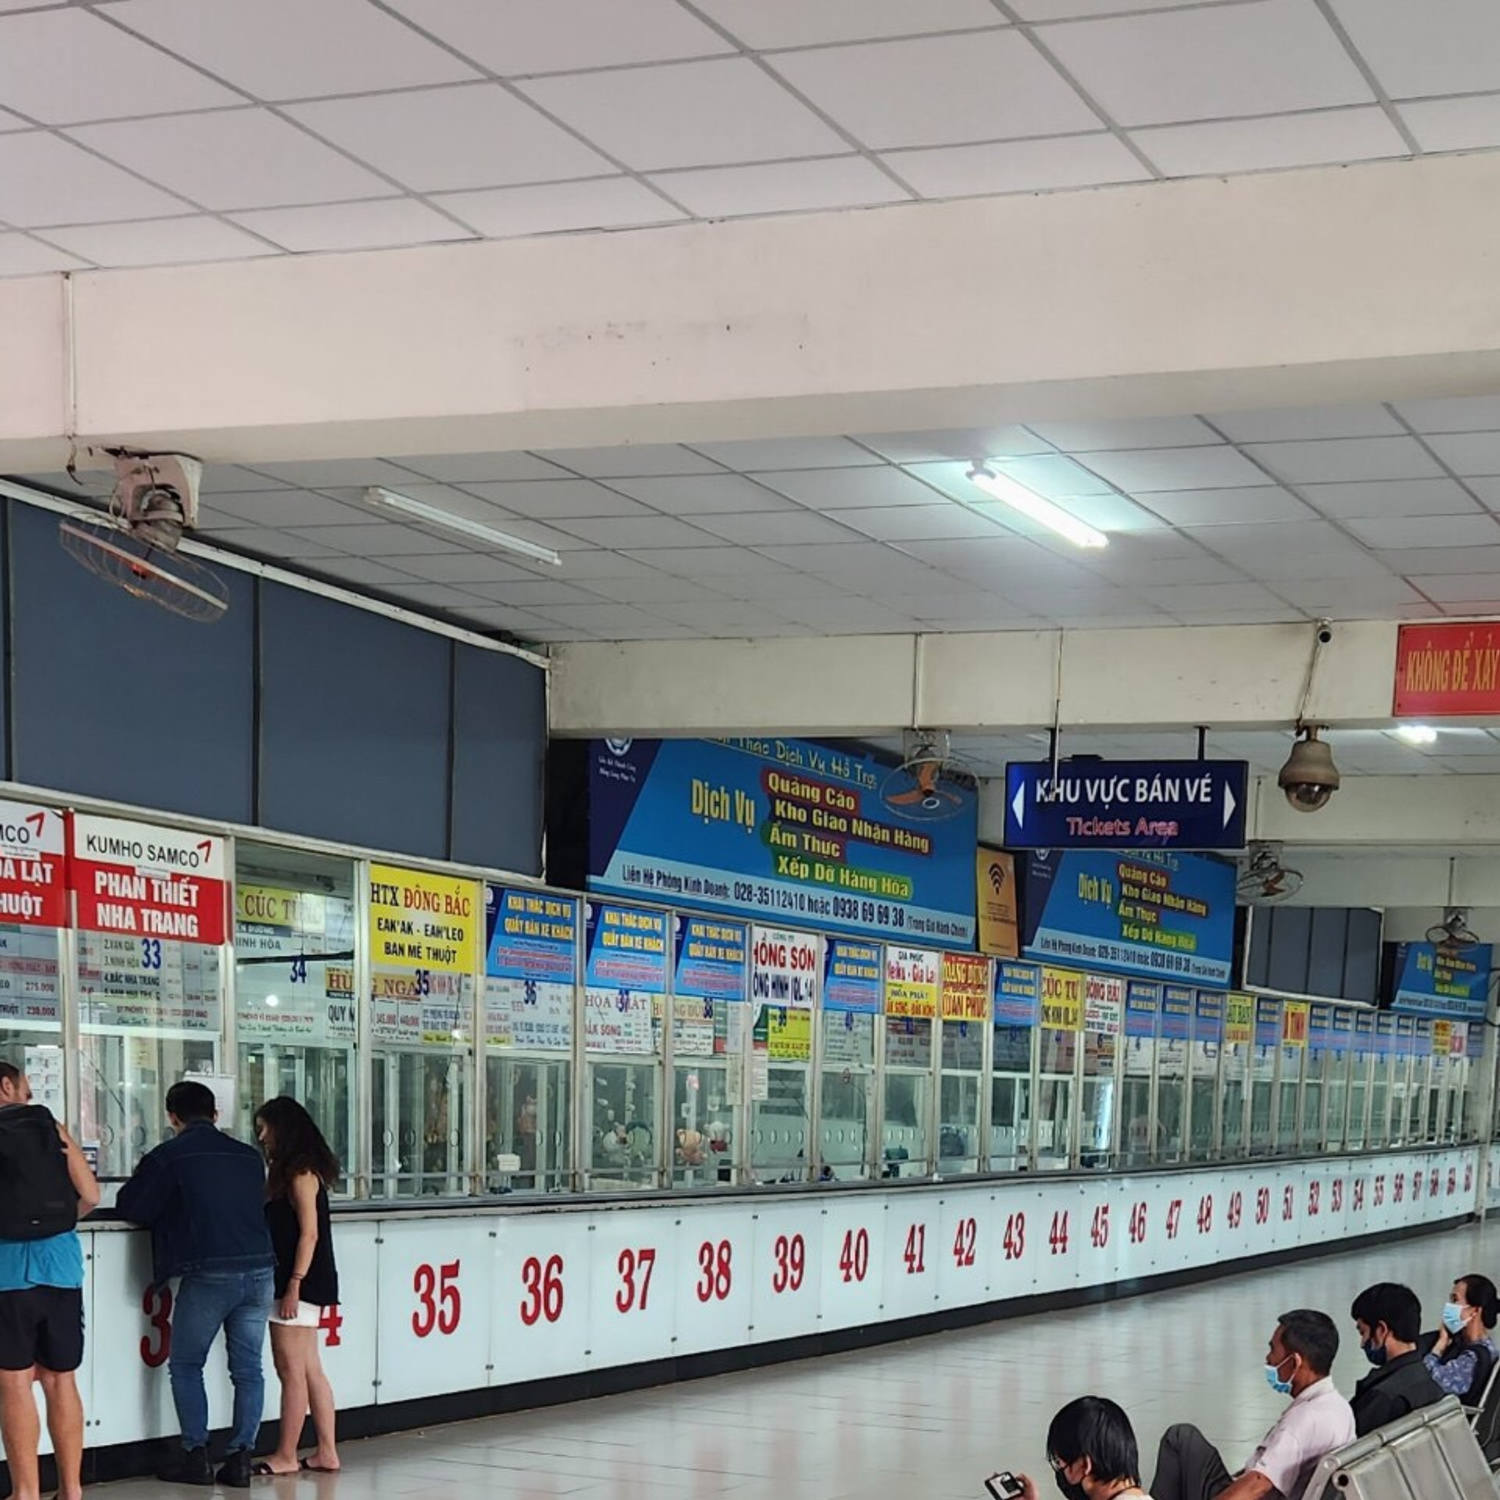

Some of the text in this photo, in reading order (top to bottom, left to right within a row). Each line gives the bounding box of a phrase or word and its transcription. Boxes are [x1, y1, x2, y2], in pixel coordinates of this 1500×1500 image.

[1407, 642, 1448, 692] KHÔNG
[1452, 631, 1474, 691] ĐỂ
[1474, 633, 1500, 690] XẢY
[776, 740, 803, 768] Dịch
[808, 746, 825, 775] Vụ
[691, 779, 755, 834] Dịch Vụ
[768, 771, 855, 810] Quảng Cáo
[1036, 774, 1213, 810] KHU VỰC BÁN VÉ
[770, 821, 841, 858] Ẩm Thực
[775, 799, 929, 854] Kho Giao Nhận Hàng
[1066, 817, 1179, 836] Tickets Area
[87, 834, 199, 868] KUMHO SAMCO
[21, 859, 54, 888] LẠT
[95, 871, 199, 908] PHAN THIẾT
[778, 855, 908, 896] Xếp Dỡ Hàng Hóa
[1079, 872, 1098, 905] Dịch
[1119, 864, 1167, 887] Quảng Cáo
[245, 889, 277, 917] CÚC
[371, 882, 399, 907] HTX
[445, 885, 470, 918] BẮC
[622, 864, 642, 882] Liên
[656, 873, 682, 893] Phòng
[684, 879, 702, 892] Kinh
[807, 895, 831, 917] hoặc
[833, 896, 859, 920] 0938
[861, 903, 875, 923] 69
[877, 905, 890, 925] 69
[892, 907, 905, 927] 38
[97, 903, 199, 938] NHA TRANG
[141, 938, 161, 970] 33
[290, 957, 306, 984] 34
[384, 941, 405, 956] BAN
[426, 945, 457, 964] THUỘT
[415, 969, 430, 996] 35
[1198, 1195, 1213, 1233] 48
[1227, 1192, 1241, 1228] 49
[1256, 1187, 1269, 1224] 50
[1283, 1185, 1293, 1221] 51
[1308, 1181, 1319, 1216] 52
[1003, 1211, 1025, 1260] 43
[1049, 1210, 1068, 1255] 44
[1091, 1203, 1109, 1248] 45
[1129, 1202, 1146, 1243] 46
[1165, 1199, 1182, 1239] 47
[839, 1228, 868, 1283] 40
[903, 1224, 925, 1273] 41
[953, 1218, 976, 1267] 42
[616, 1248, 656, 1313] 37
[697, 1239, 731, 1302] 38
[773, 1233, 804, 1293] 39
[412, 1260, 461, 1337] 35
[520, 1254, 563, 1325] 36
[140, 1284, 171, 1368] 3
[317, 1304, 343, 1346] 4
